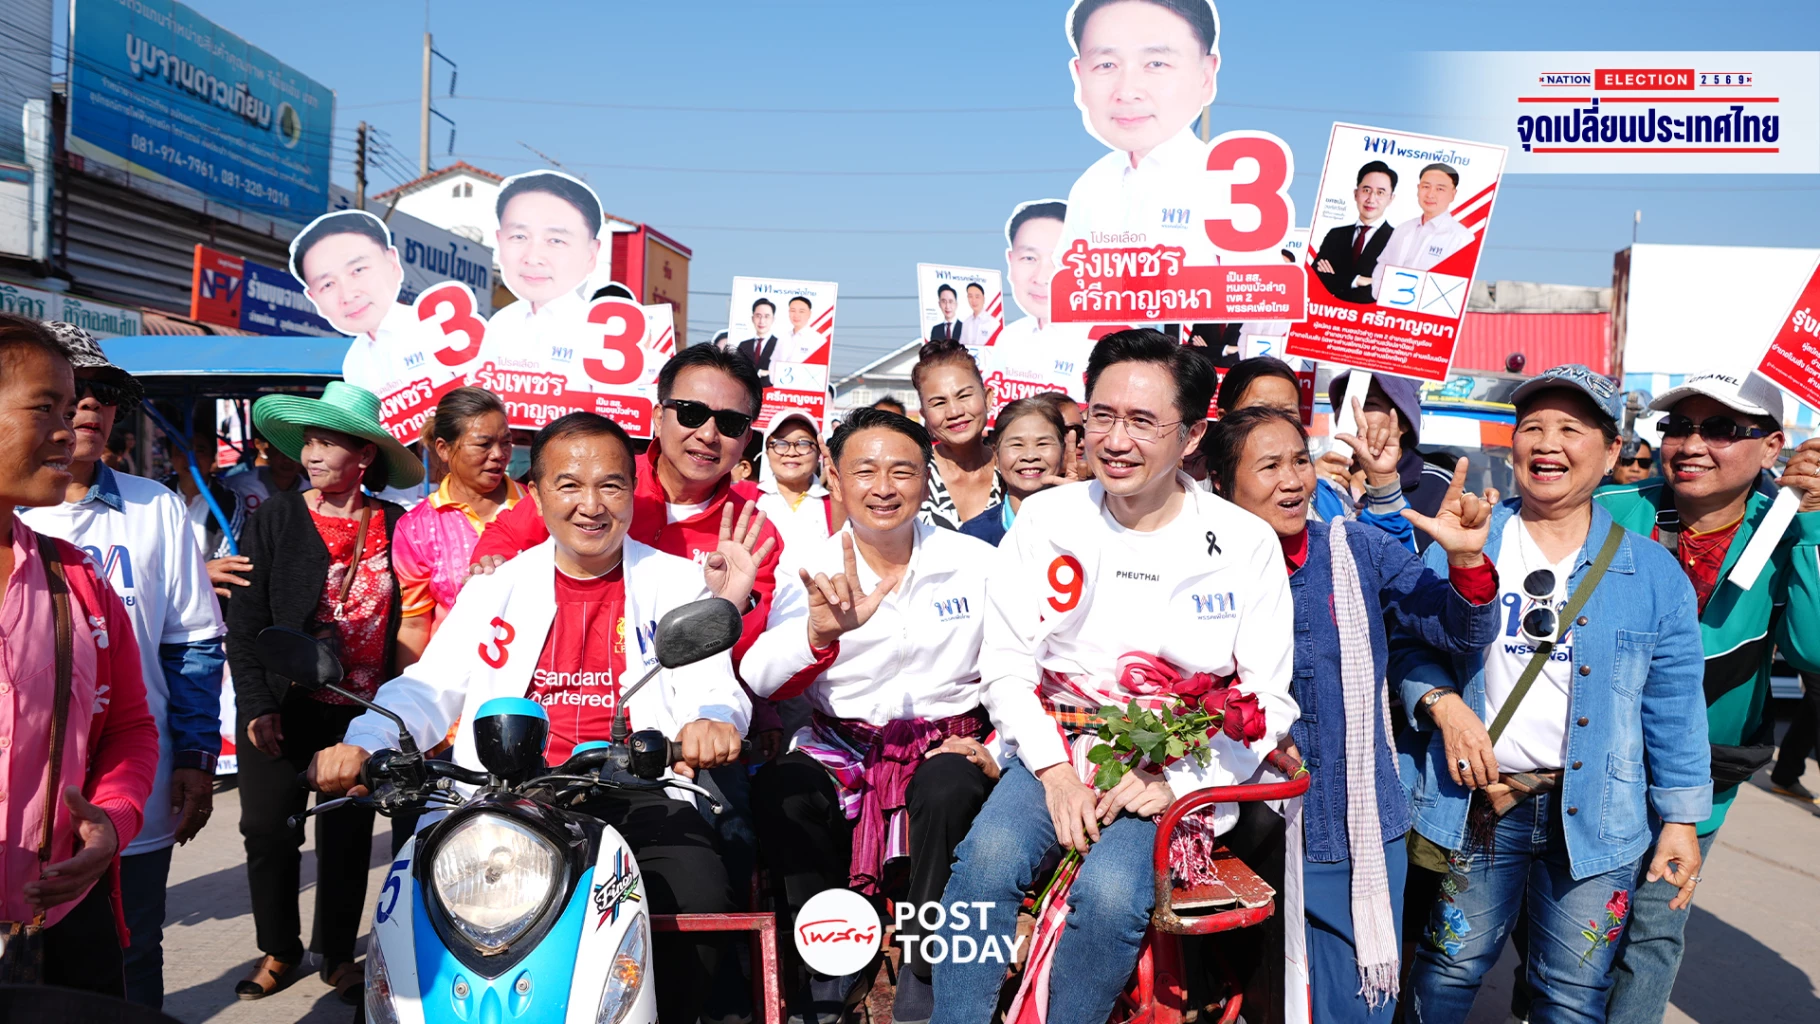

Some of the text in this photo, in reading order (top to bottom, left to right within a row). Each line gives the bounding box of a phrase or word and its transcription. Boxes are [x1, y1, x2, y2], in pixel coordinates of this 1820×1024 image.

[126, 33, 271, 126] บูมจานดาวเทียม
[1363, 135, 1471, 167] พท พรรคเพื่อไทย
[1204, 137, 1289, 252] 3
[1161, 207, 1191, 224] พท
[1090, 231, 1147, 244] โปรดเลือก
[1066, 243, 1182, 289] รุ่งเพชร
[1226, 271, 1244, 283] เป็น
[1226, 281, 1286, 295] หนองบัวลำภู
[1226, 294, 1253, 303] เขต 2
[1389, 271, 1419, 306] 3
[1069, 283, 1212, 319] ศรีกาญจนา
[1226, 301, 1290, 314] พรรคเพื่อไทย
[417, 285, 486, 367] 3
[1306, 297, 1455, 339] งเพชร ศรีกาญจนา
[583, 301, 646, 386] 3
[497, 356, 540, 369] โปรดเลือก
[1005, 366, 1044, 381] โปรดเลือก
[478, 364, 565, 397] ร่งเพชร
[1688, 373, 1740, 387] CHANEL
[766, 390, 824, 406] ศรีกาญจนา
[1047, 554, 1085, 613] 9
[1115, 570, 1161, 582] PHEUTHAI
[1191, 591, 1236, 613] พท
[478, 616, 516, 669] 3
[534, 668, 613, 687] Sandard
[529, 690, 615, 709] hartered
[376, 859, 411, 925] 5
